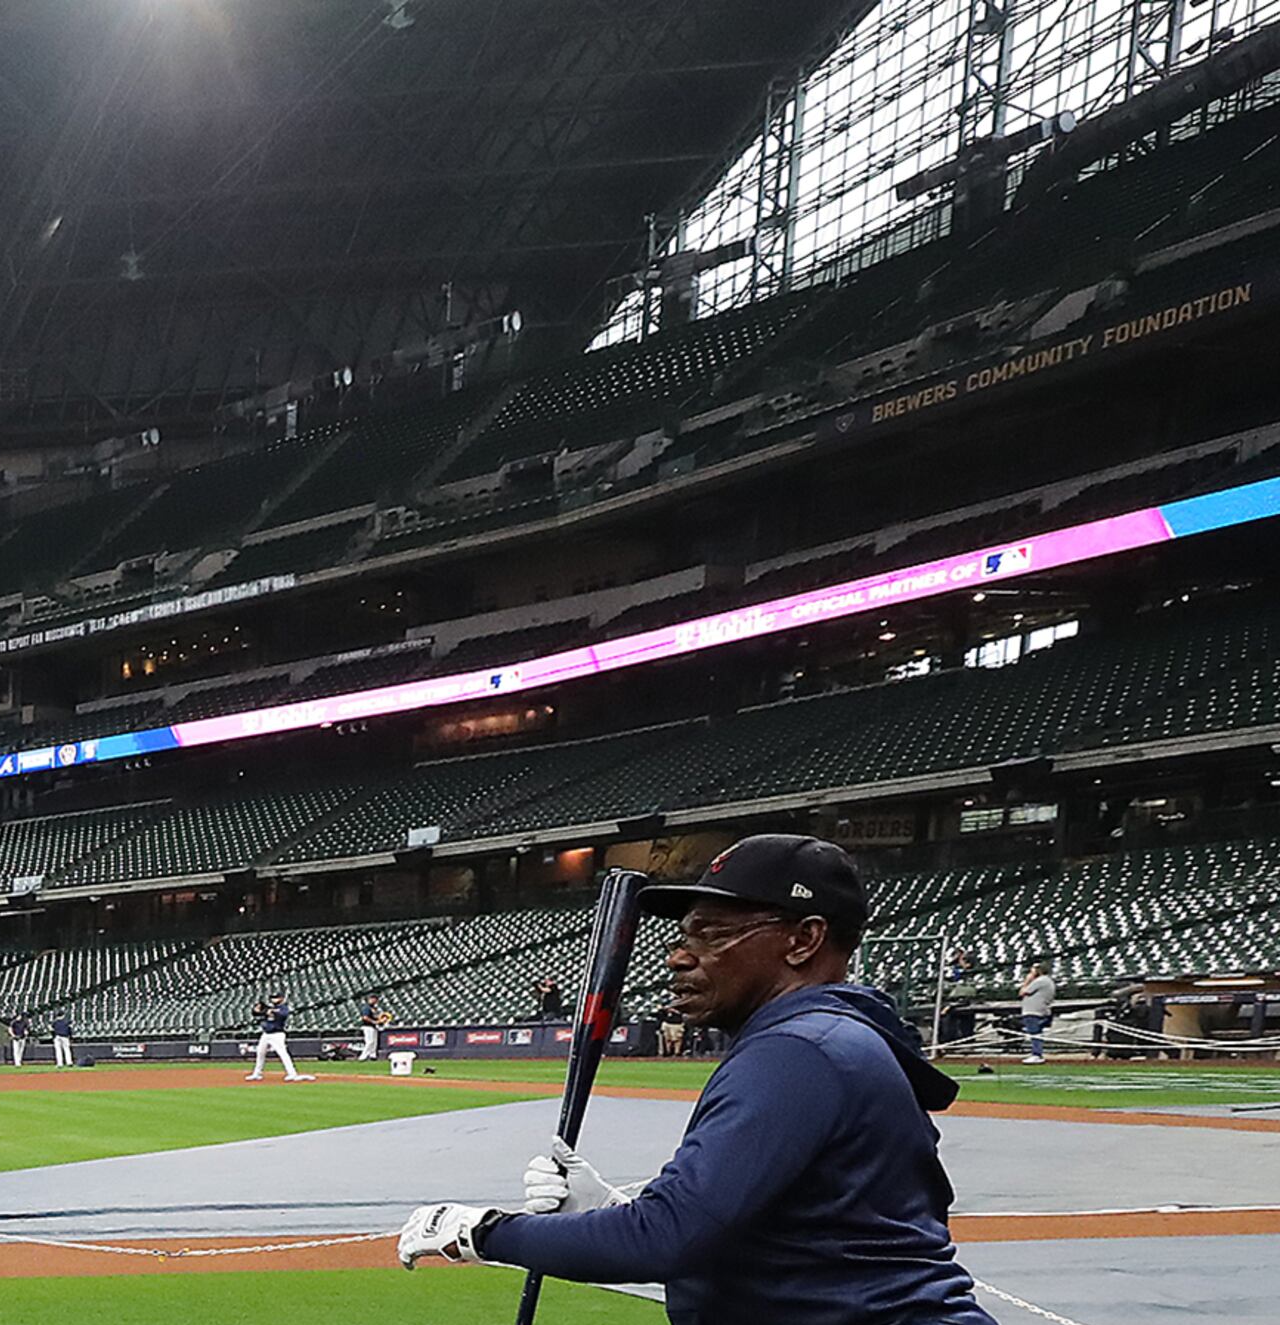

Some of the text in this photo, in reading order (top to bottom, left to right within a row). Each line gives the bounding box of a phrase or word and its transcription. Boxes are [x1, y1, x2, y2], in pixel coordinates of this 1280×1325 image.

[871, 283, 1252, 425] BREWERS COMMUNITY FOUNDATION
[791, 593, 863, 619] OFFICIAL
[866, 572, 946, 603] PARTNER
[950, 562, 977, 582] OF
